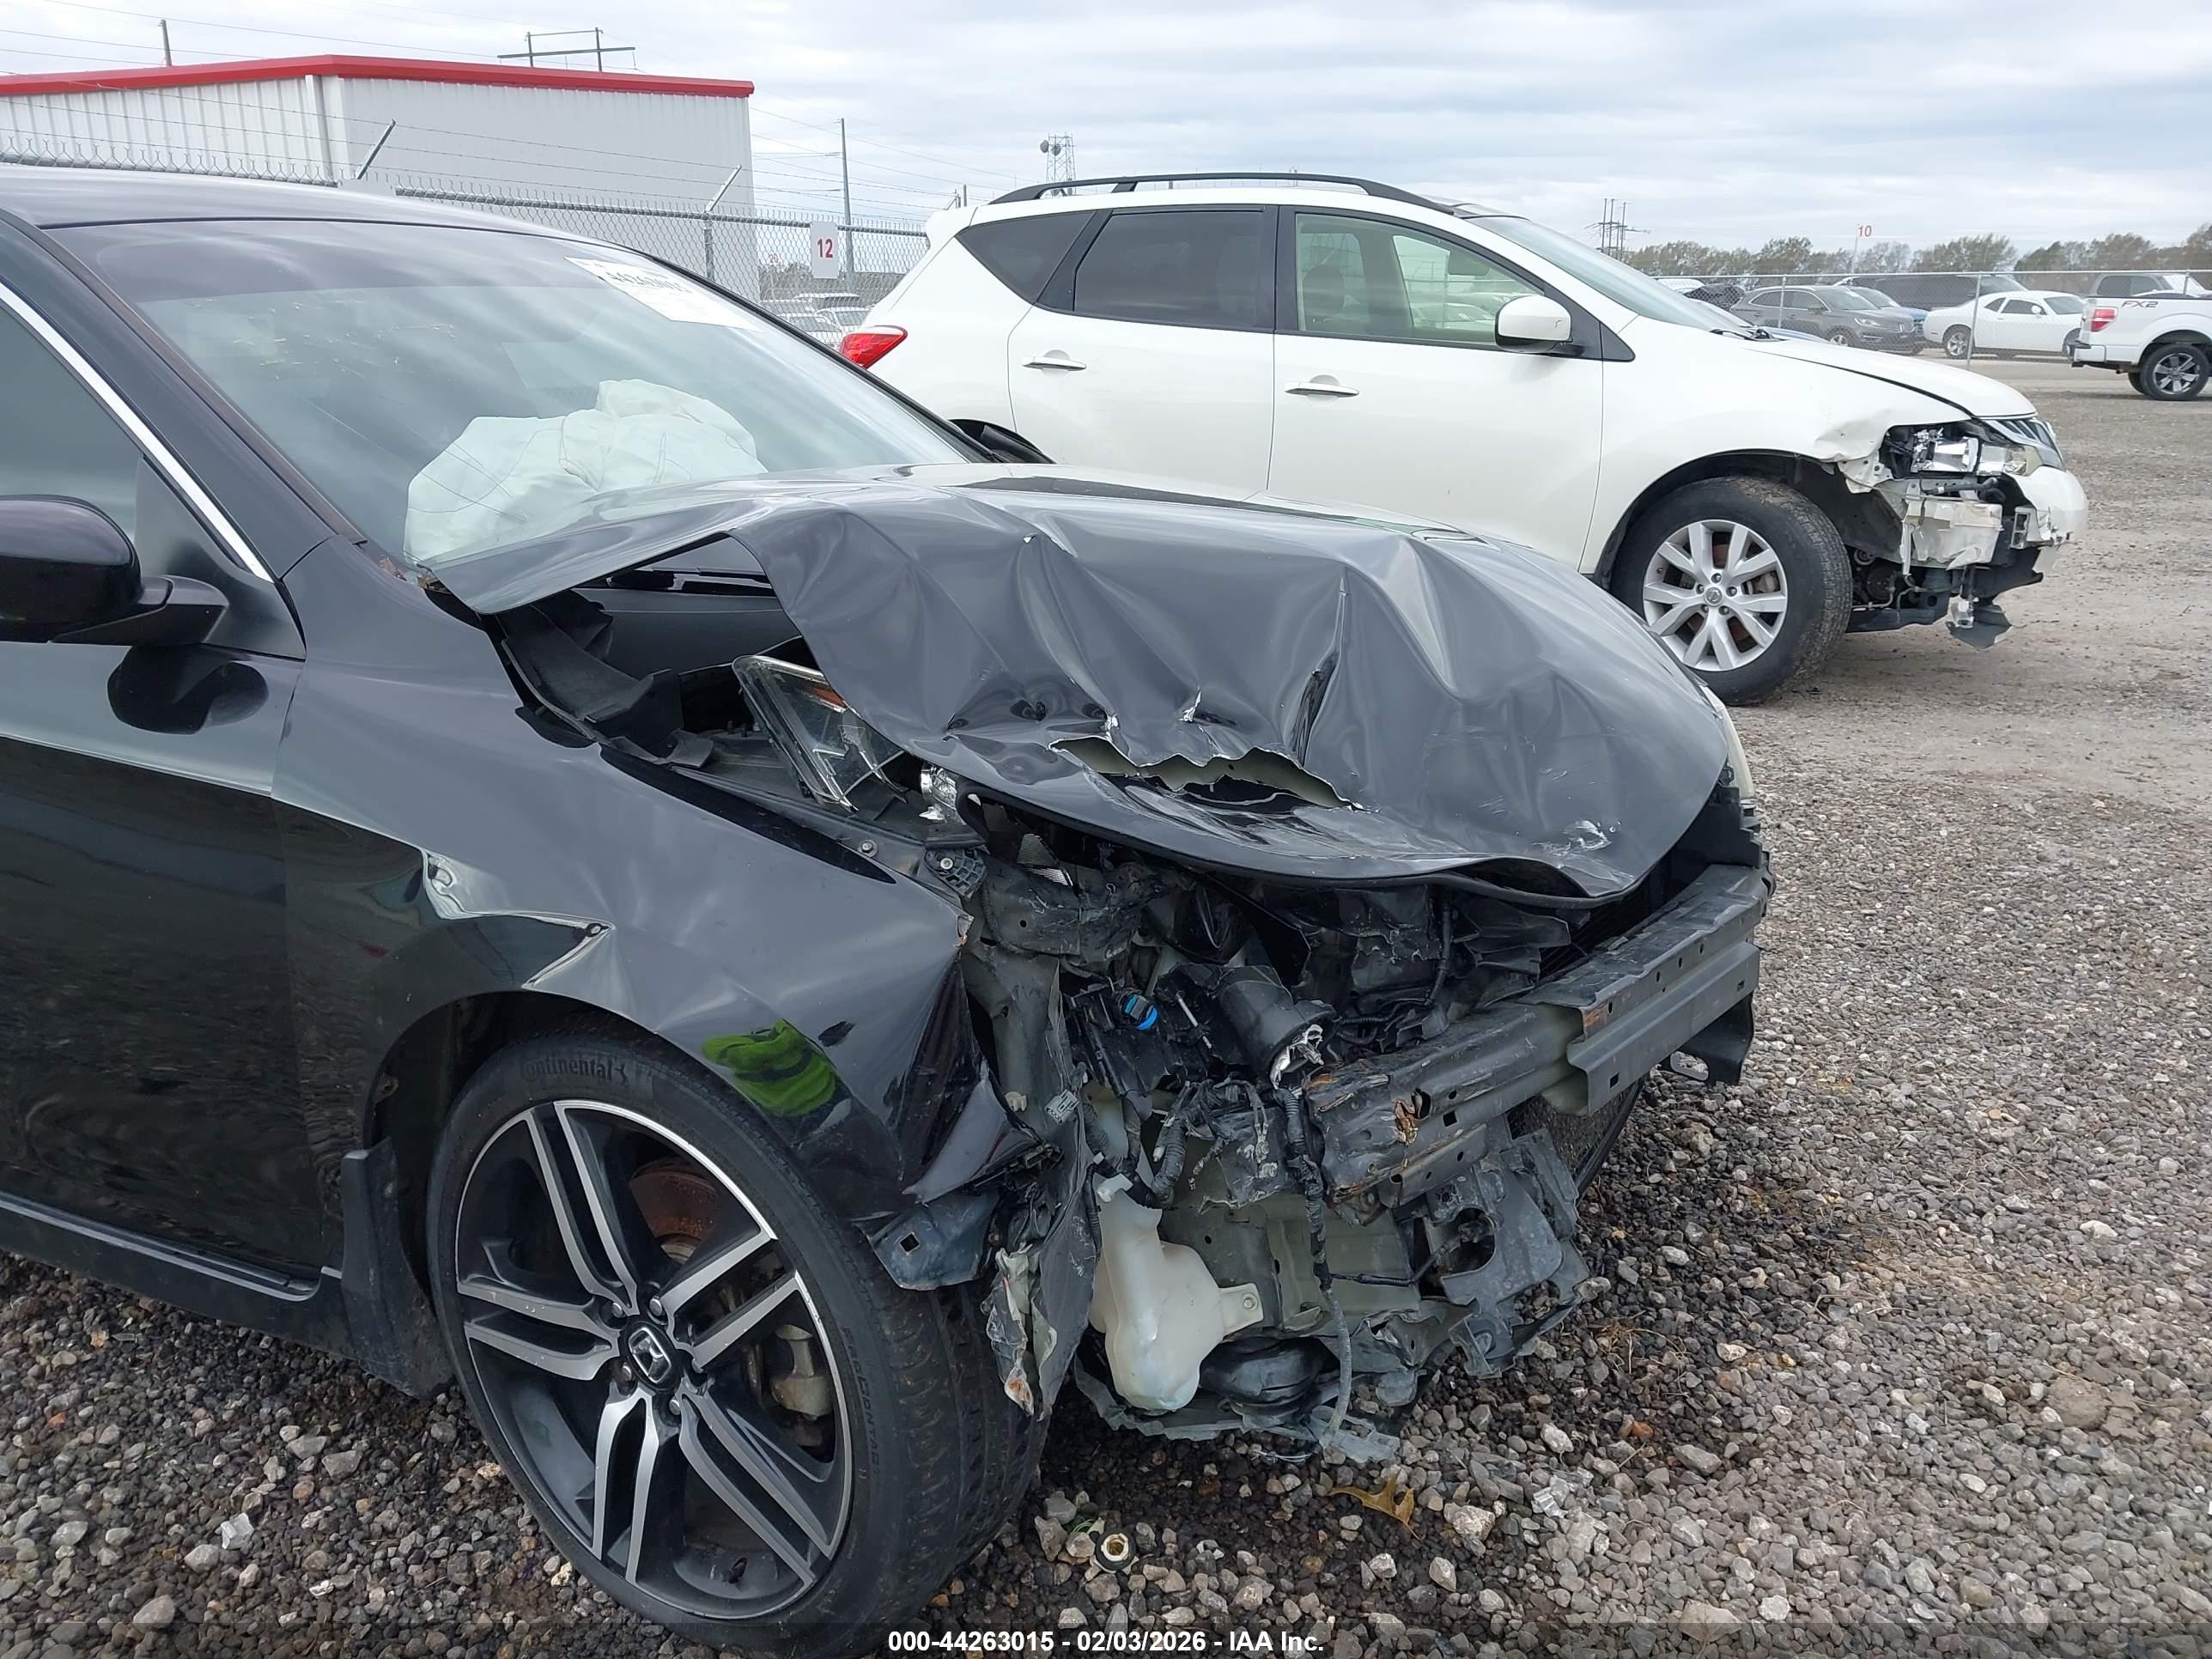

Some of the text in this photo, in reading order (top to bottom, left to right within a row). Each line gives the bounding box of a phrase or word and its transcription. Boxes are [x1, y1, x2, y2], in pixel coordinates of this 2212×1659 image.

[1857, 224, 1872, 238] 10
[817, 238, 834, 258] 12
[521, 1054, 613, 1083] Continental
